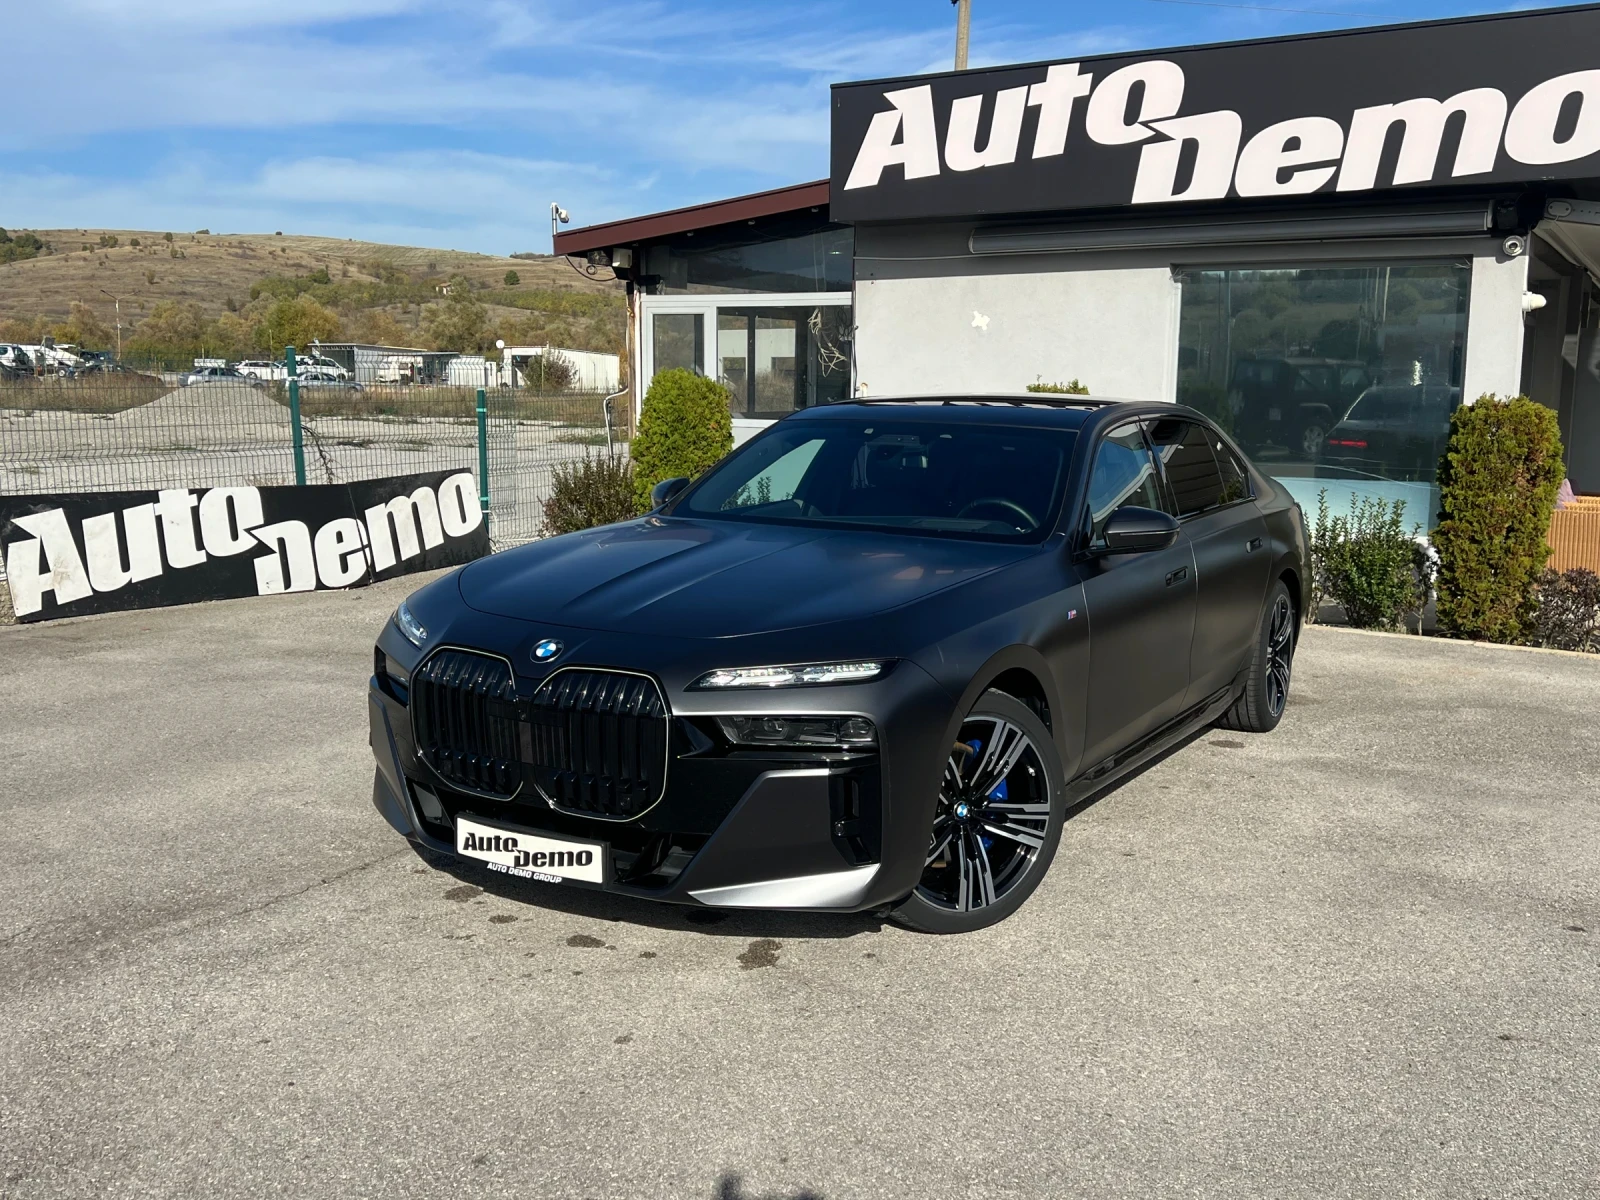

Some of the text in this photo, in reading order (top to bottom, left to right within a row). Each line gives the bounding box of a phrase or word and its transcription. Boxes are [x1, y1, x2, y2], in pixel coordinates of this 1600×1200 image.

[844, 60, 1185, 190] Auto
[1131, 69, 1600, 205] Demo
[6, 485, 264, 617] Auto
[248, 472, 483, 596] Demo
[463, 832, 518, 853] Auto
[487, 862, 562, 884] AUTO DEMO GROUP
[513, 850, 593, 867] Demo
